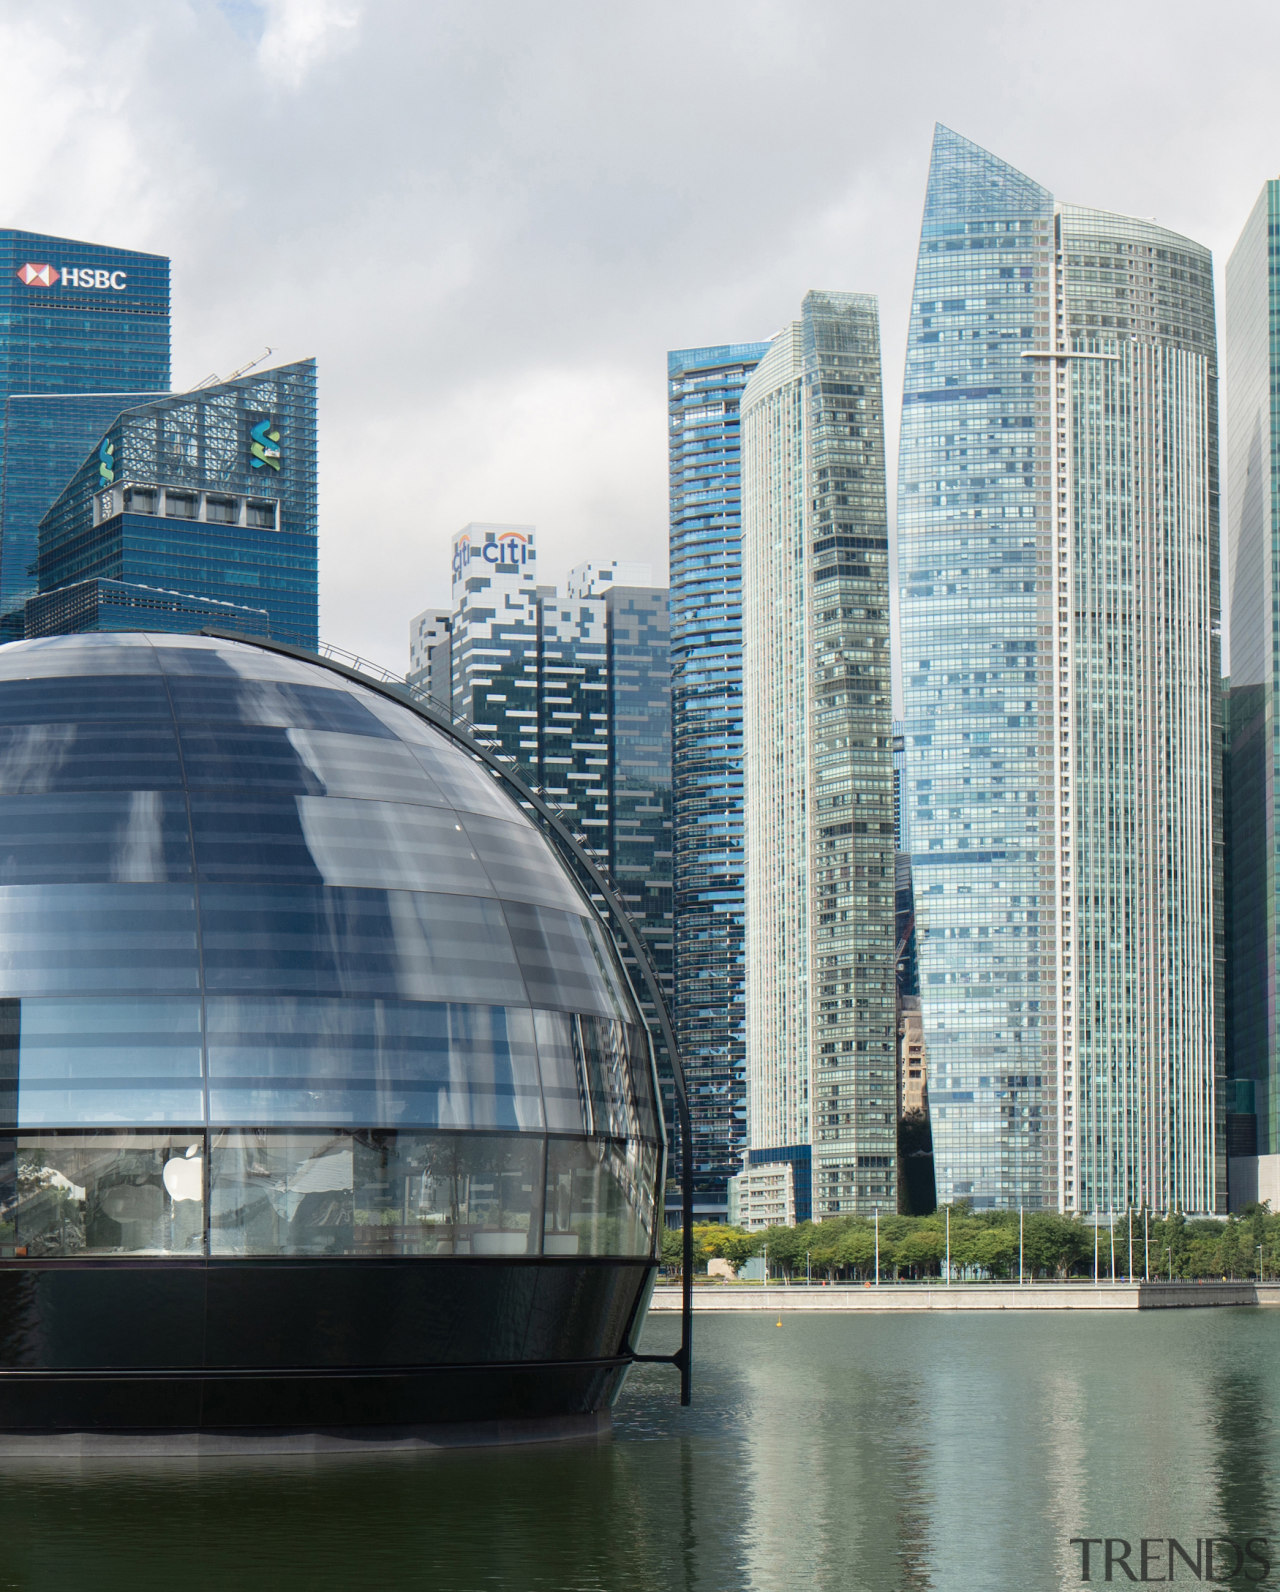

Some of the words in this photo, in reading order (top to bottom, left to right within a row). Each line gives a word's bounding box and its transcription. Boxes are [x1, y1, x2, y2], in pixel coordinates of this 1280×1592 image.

[61, 266, 127, 290] HSBC
[452, 541, 470, 573] citi
[482, 538, 526, 564] citi
